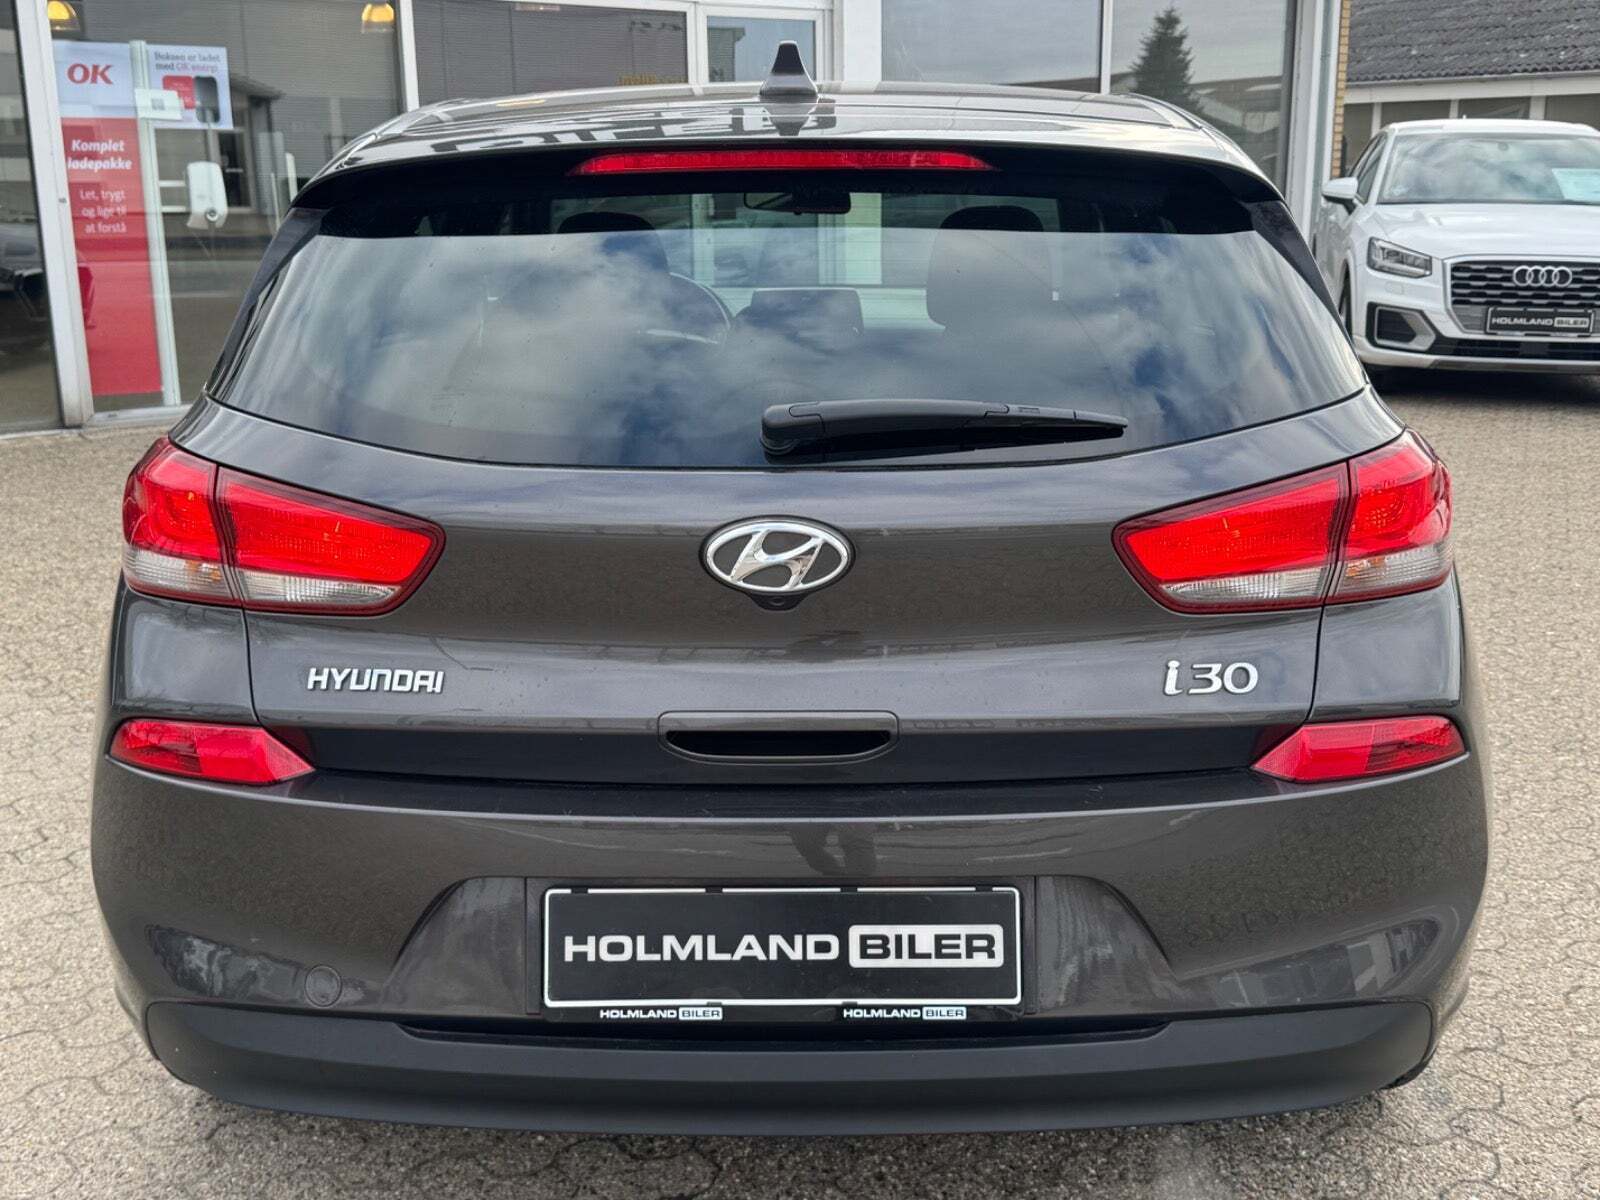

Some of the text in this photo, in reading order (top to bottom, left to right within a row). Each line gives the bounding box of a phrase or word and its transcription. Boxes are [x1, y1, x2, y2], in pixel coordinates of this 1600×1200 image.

[67, 63, 113, 85] OK
[71, 139, 125, 154] Komplet
[67, 156, 133, 173] ladepakke
[79, 189, 126, 203] Let, trygt
[1491, 316, 1588, 327] HOLMLAND BILER
[307, 667, 444, 694] HYUNDAI
[1163, 659, 1259, 695] i30
[563, 932, 998, 963] HOLMLAND BILER
[599, 1008, 722, 1019] HOLMLAND BILER
[842, 1007, 966, 1018] HOLMLAND BILER
